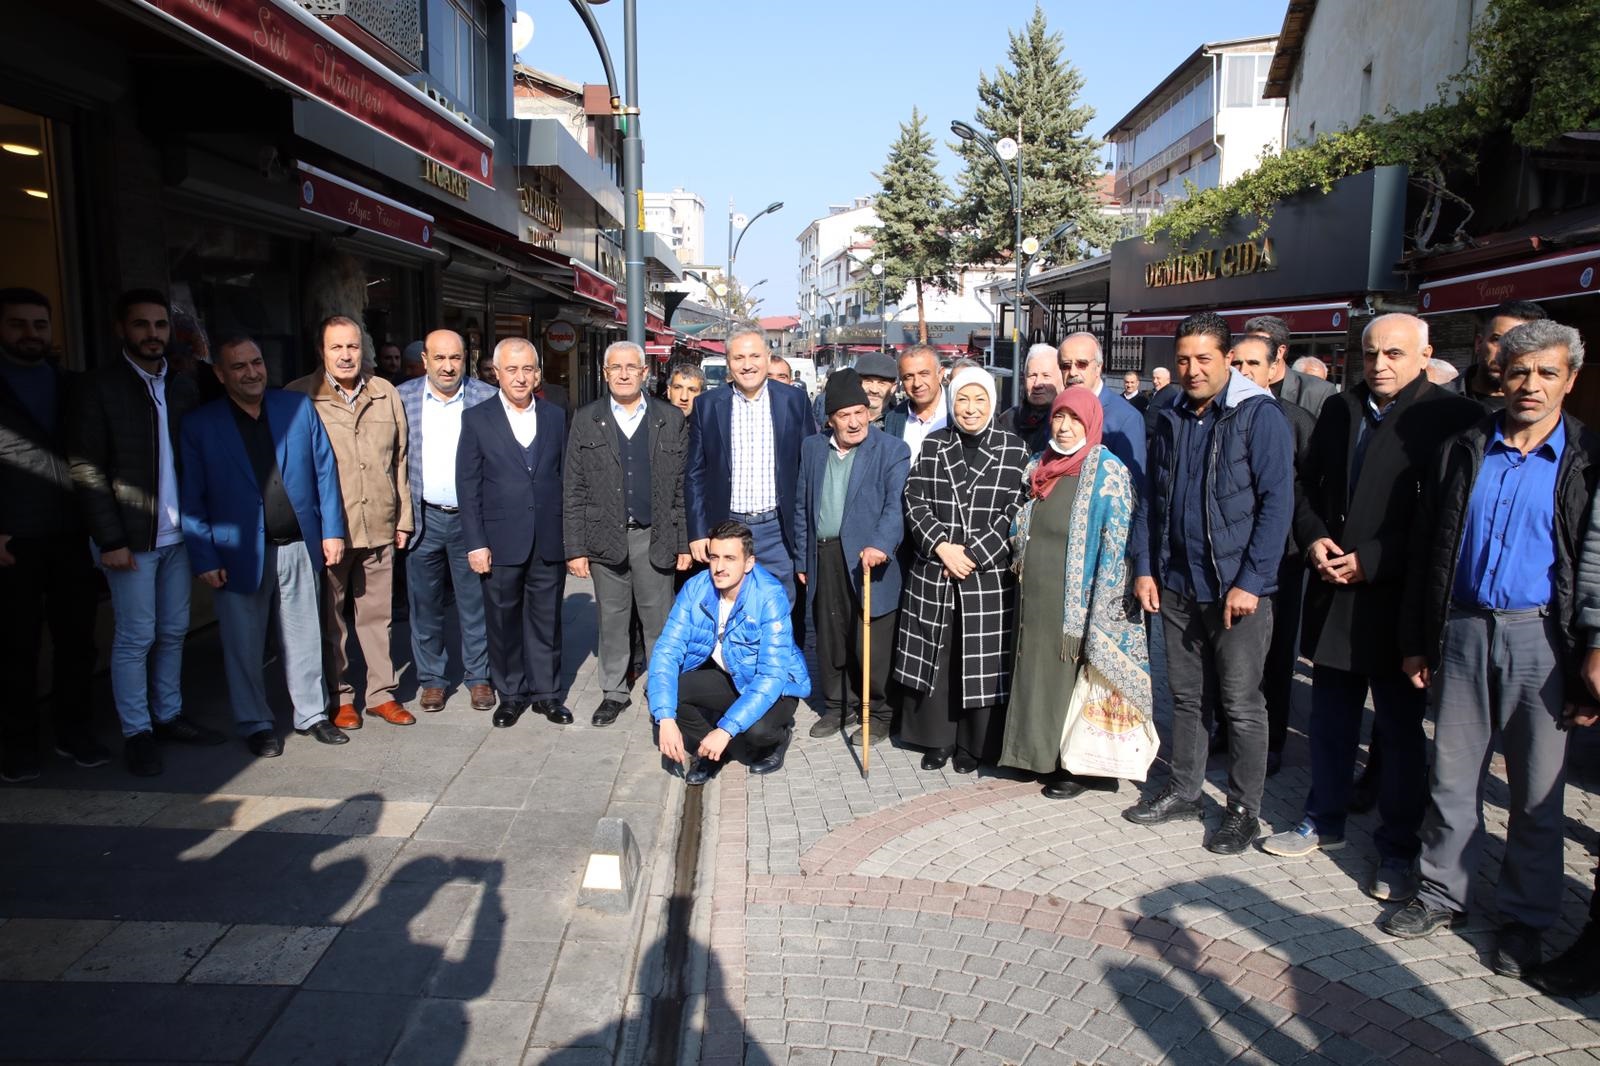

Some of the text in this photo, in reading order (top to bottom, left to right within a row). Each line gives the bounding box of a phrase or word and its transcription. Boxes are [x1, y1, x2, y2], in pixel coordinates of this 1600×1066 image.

[253, 6, 291, 61] Süt
[313, 42, 384, 114] Ürünleri
[1221, 237, 1278, 278] GIDA
